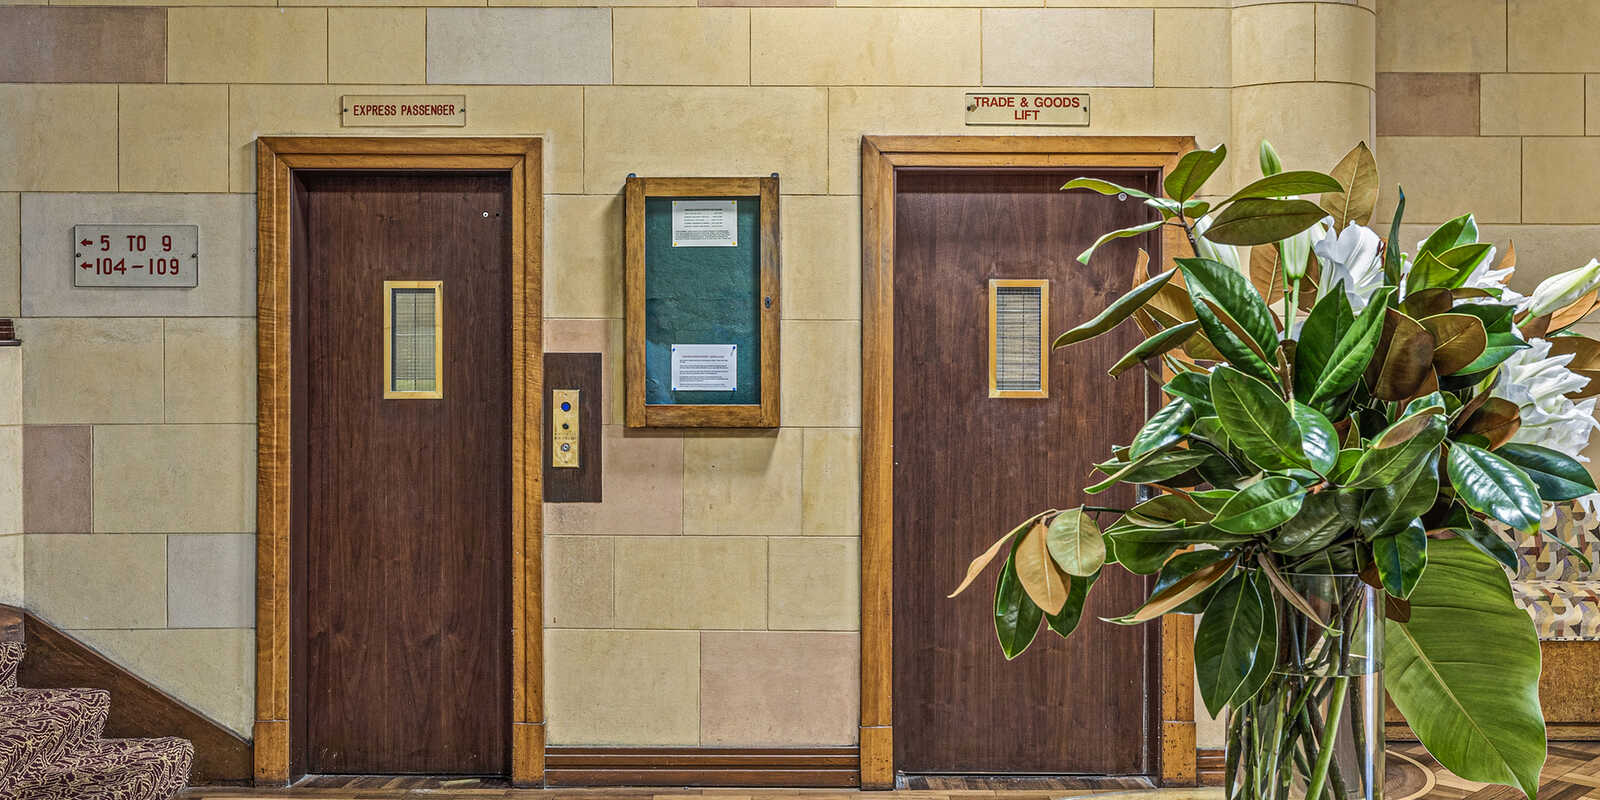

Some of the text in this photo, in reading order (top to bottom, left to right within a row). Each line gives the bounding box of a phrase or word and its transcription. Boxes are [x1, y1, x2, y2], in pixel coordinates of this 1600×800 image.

[974, 96, 1080, 108] TRADE & GOODS
[353, 104, 455, 116] EXPRESS PASSENGER
[1014, 110, 1040, 121] LIFT
[100, 235, 172, 251] 5 TO 9
